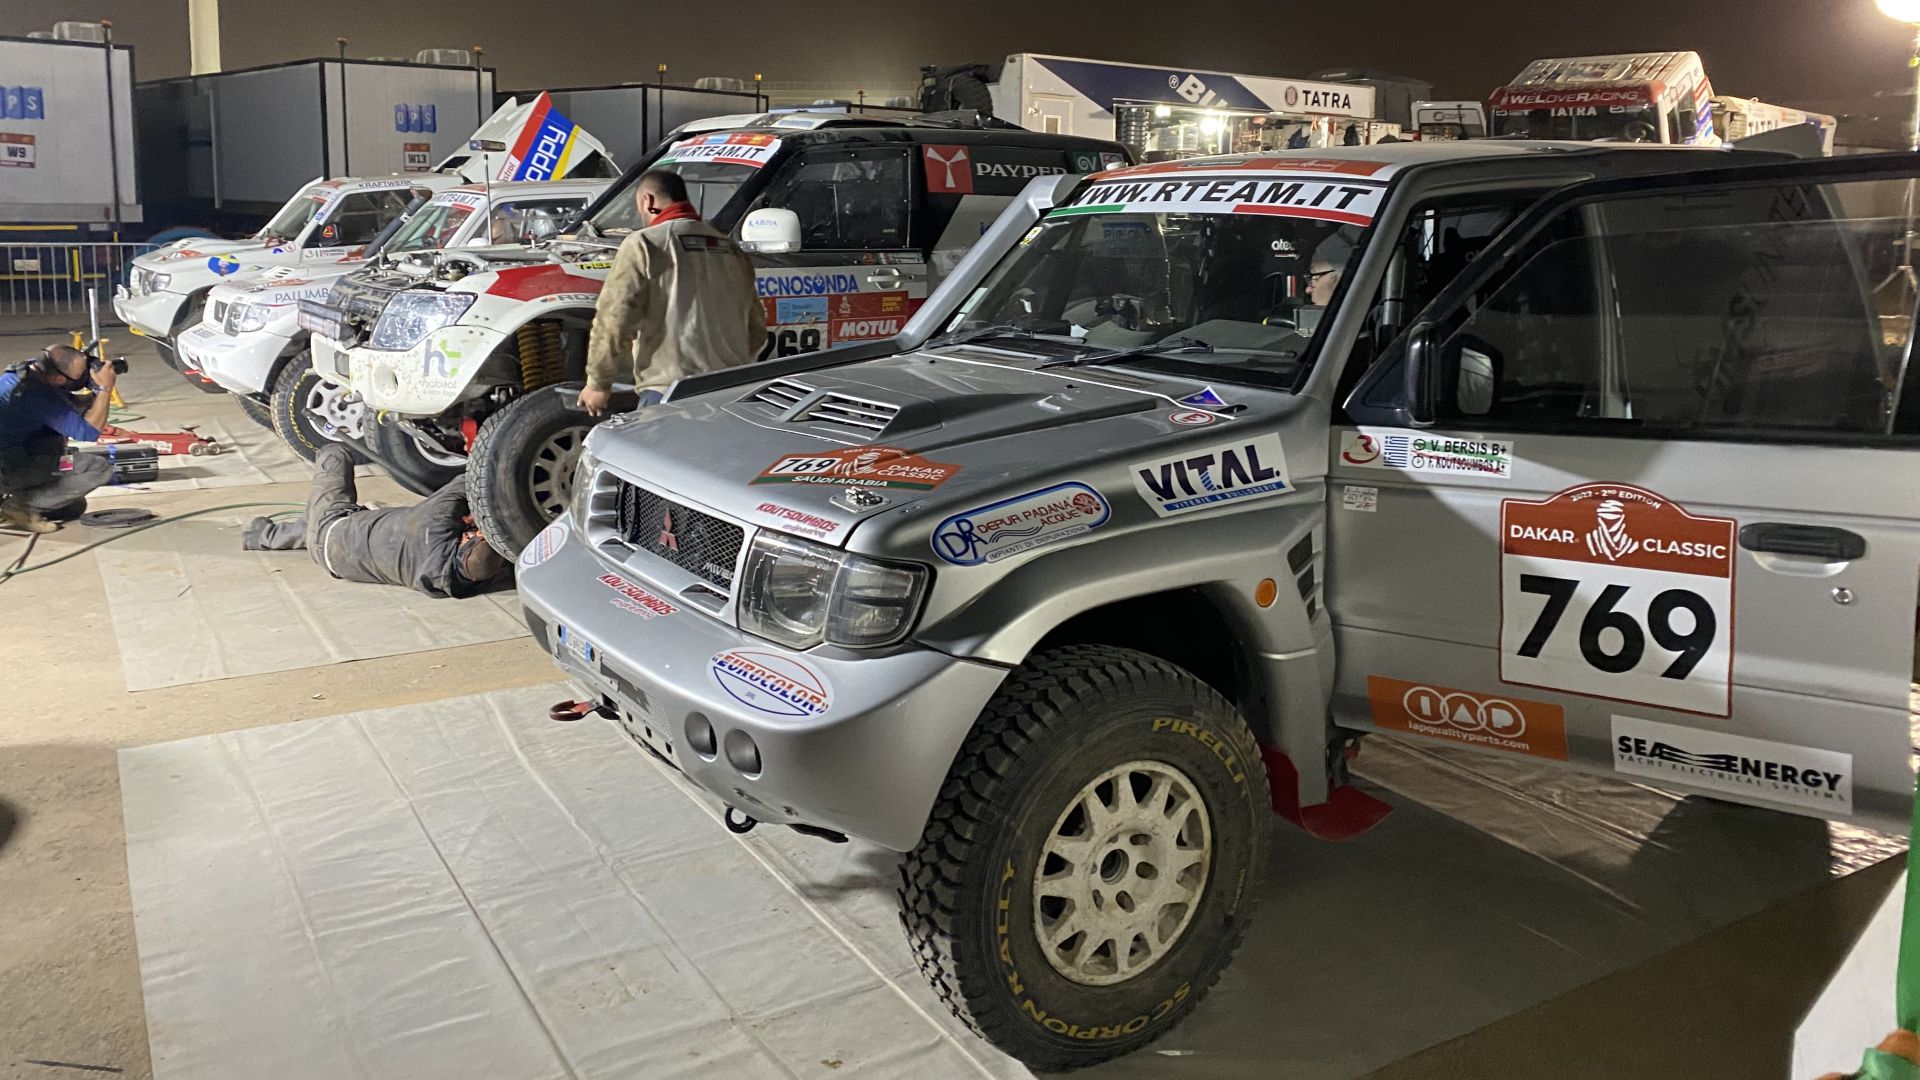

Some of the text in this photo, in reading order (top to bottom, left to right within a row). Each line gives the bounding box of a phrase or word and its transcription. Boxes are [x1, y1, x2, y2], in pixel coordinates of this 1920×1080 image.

[1303, 89, 1351, 109] TATRA
[396, 111, 432, 125] OPS
[408, 154, 427, 164] W13
[523, 125, 567, 181] oppy
[756, 273, 860, 296] ECNOSONDA
[839, 320, 899, 337] MOTUL
[1431, 440, 1440, 451] V.
[1445, 441, 1487, 455] BERSIS
[774, 458, 837, 473] 769
[877, 469, 944, 480] CLASSIC
[888, 465, 945, 474] DAKAR
[792, 476, 888, 487] SAUDI ARABIA
[1619, 489, 1662, 510] EDITION
[756, 503, 839, 532] KOUTSOUMBOS
[976, 499, 1073, 535] DEPUR PADANA
[1040, 510, 1081, 527] ACQUE
[1511, 525, 1726, 559] DAKAR CLASSIC
[600, 574, 678, 615] KOUTSOUMBOS
[1516, 574, 1717, 680] 769
[1152, 718, 1244, 784] PIRELLI
[1620, 754, 1846, 802] YACHT ELECTRICAL SYSTEMS
[1725, 755, 1843, 791] ENERGY
[998, 858, 1192, 1040] SCORPION RALLY
